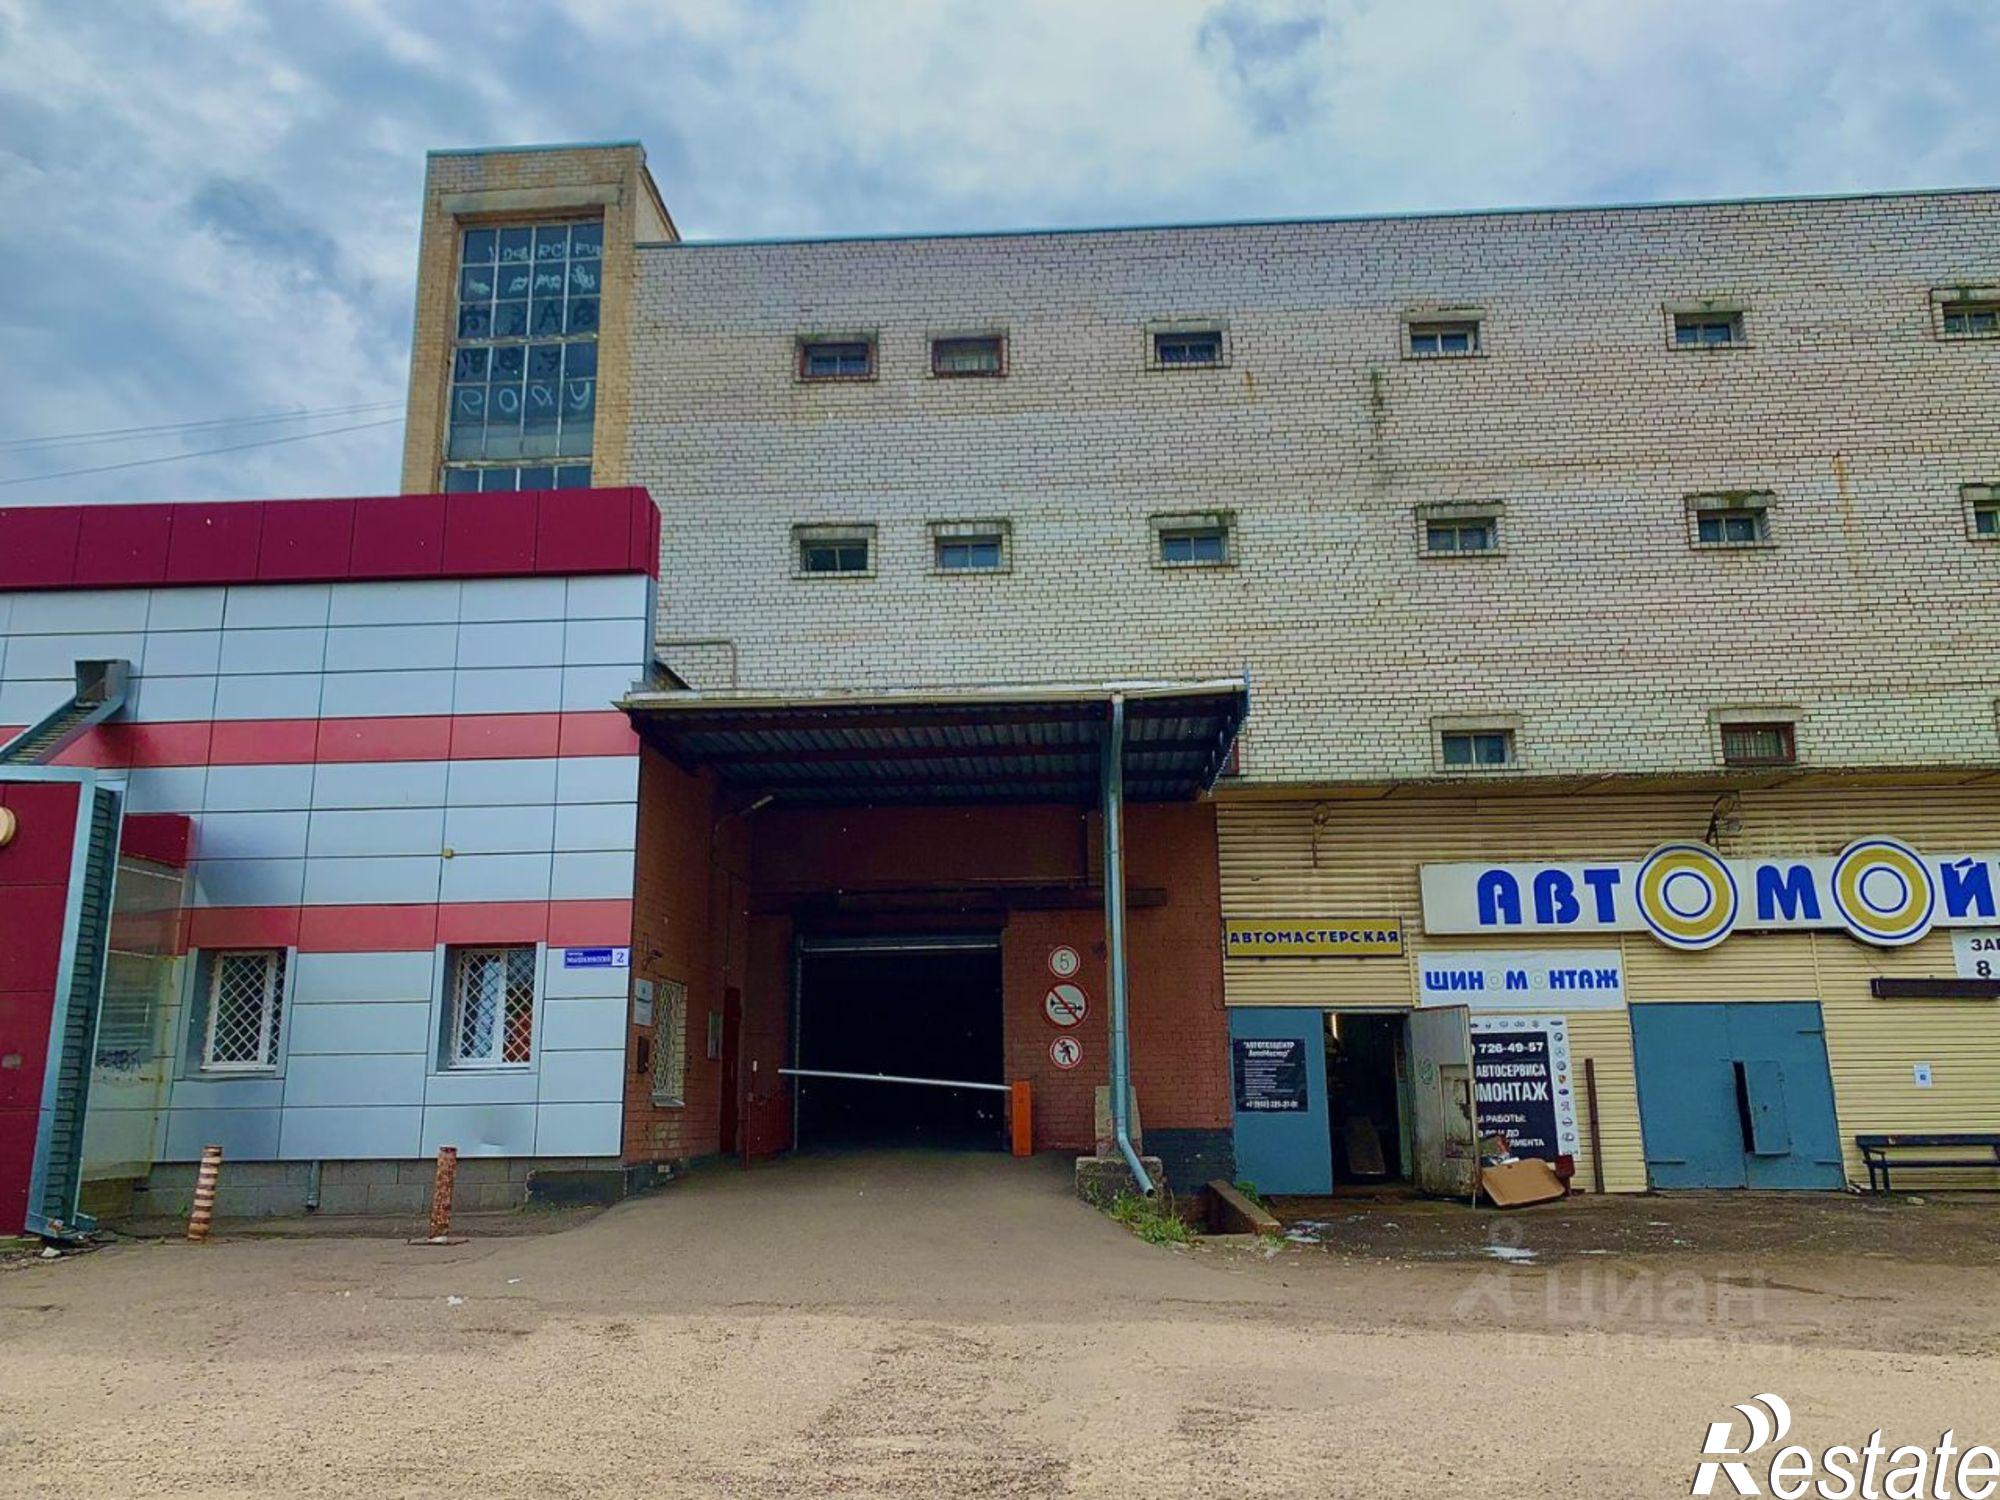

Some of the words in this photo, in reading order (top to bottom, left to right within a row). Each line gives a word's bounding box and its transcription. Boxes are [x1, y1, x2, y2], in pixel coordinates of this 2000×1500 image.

[1476, 834, 2000, 951] АВТОМОЙ
[1229, 930, 1399, 944] АВТОМАСТЕРСКАЯ
[616, 952, 625, 964] 2
[1059, 954, 1070, 970] 5
